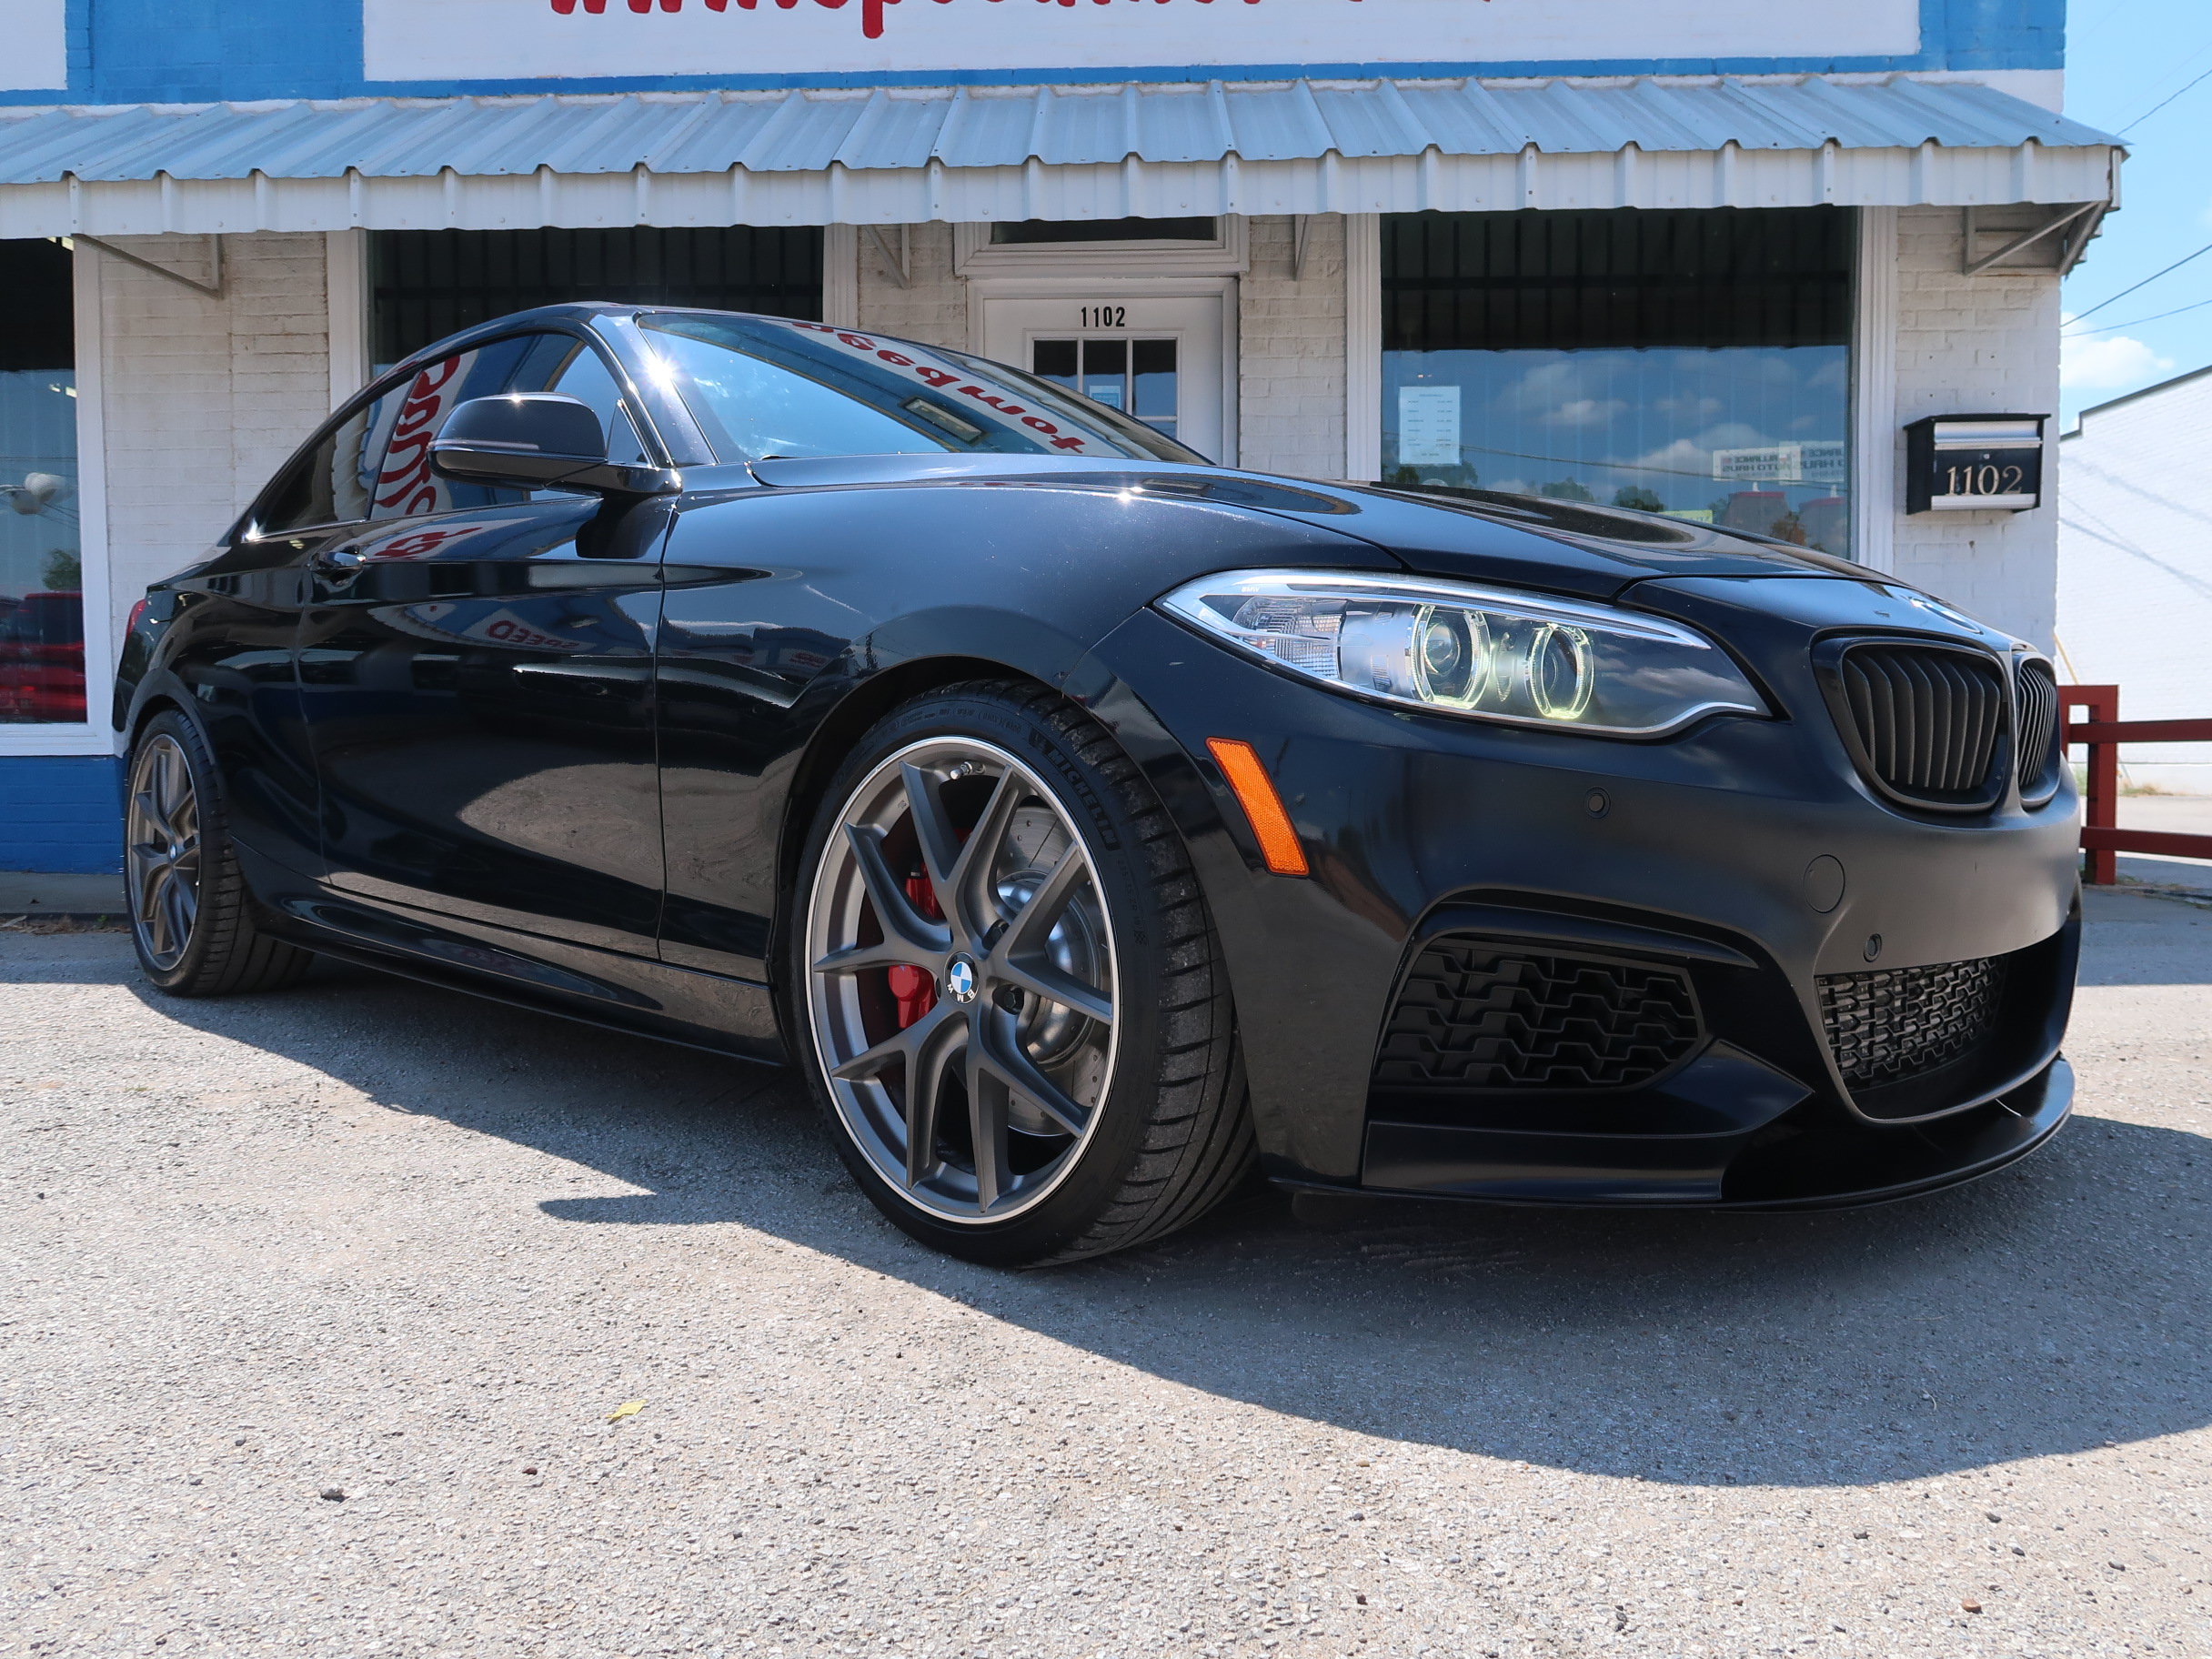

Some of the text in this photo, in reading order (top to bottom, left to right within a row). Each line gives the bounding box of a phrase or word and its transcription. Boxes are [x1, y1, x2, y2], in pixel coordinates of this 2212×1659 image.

[1081, 306, 1125, 327] 1102
[1945, 465, 2024, 496] 1102
[1047, 747, 1120, 845] MICHELIN
